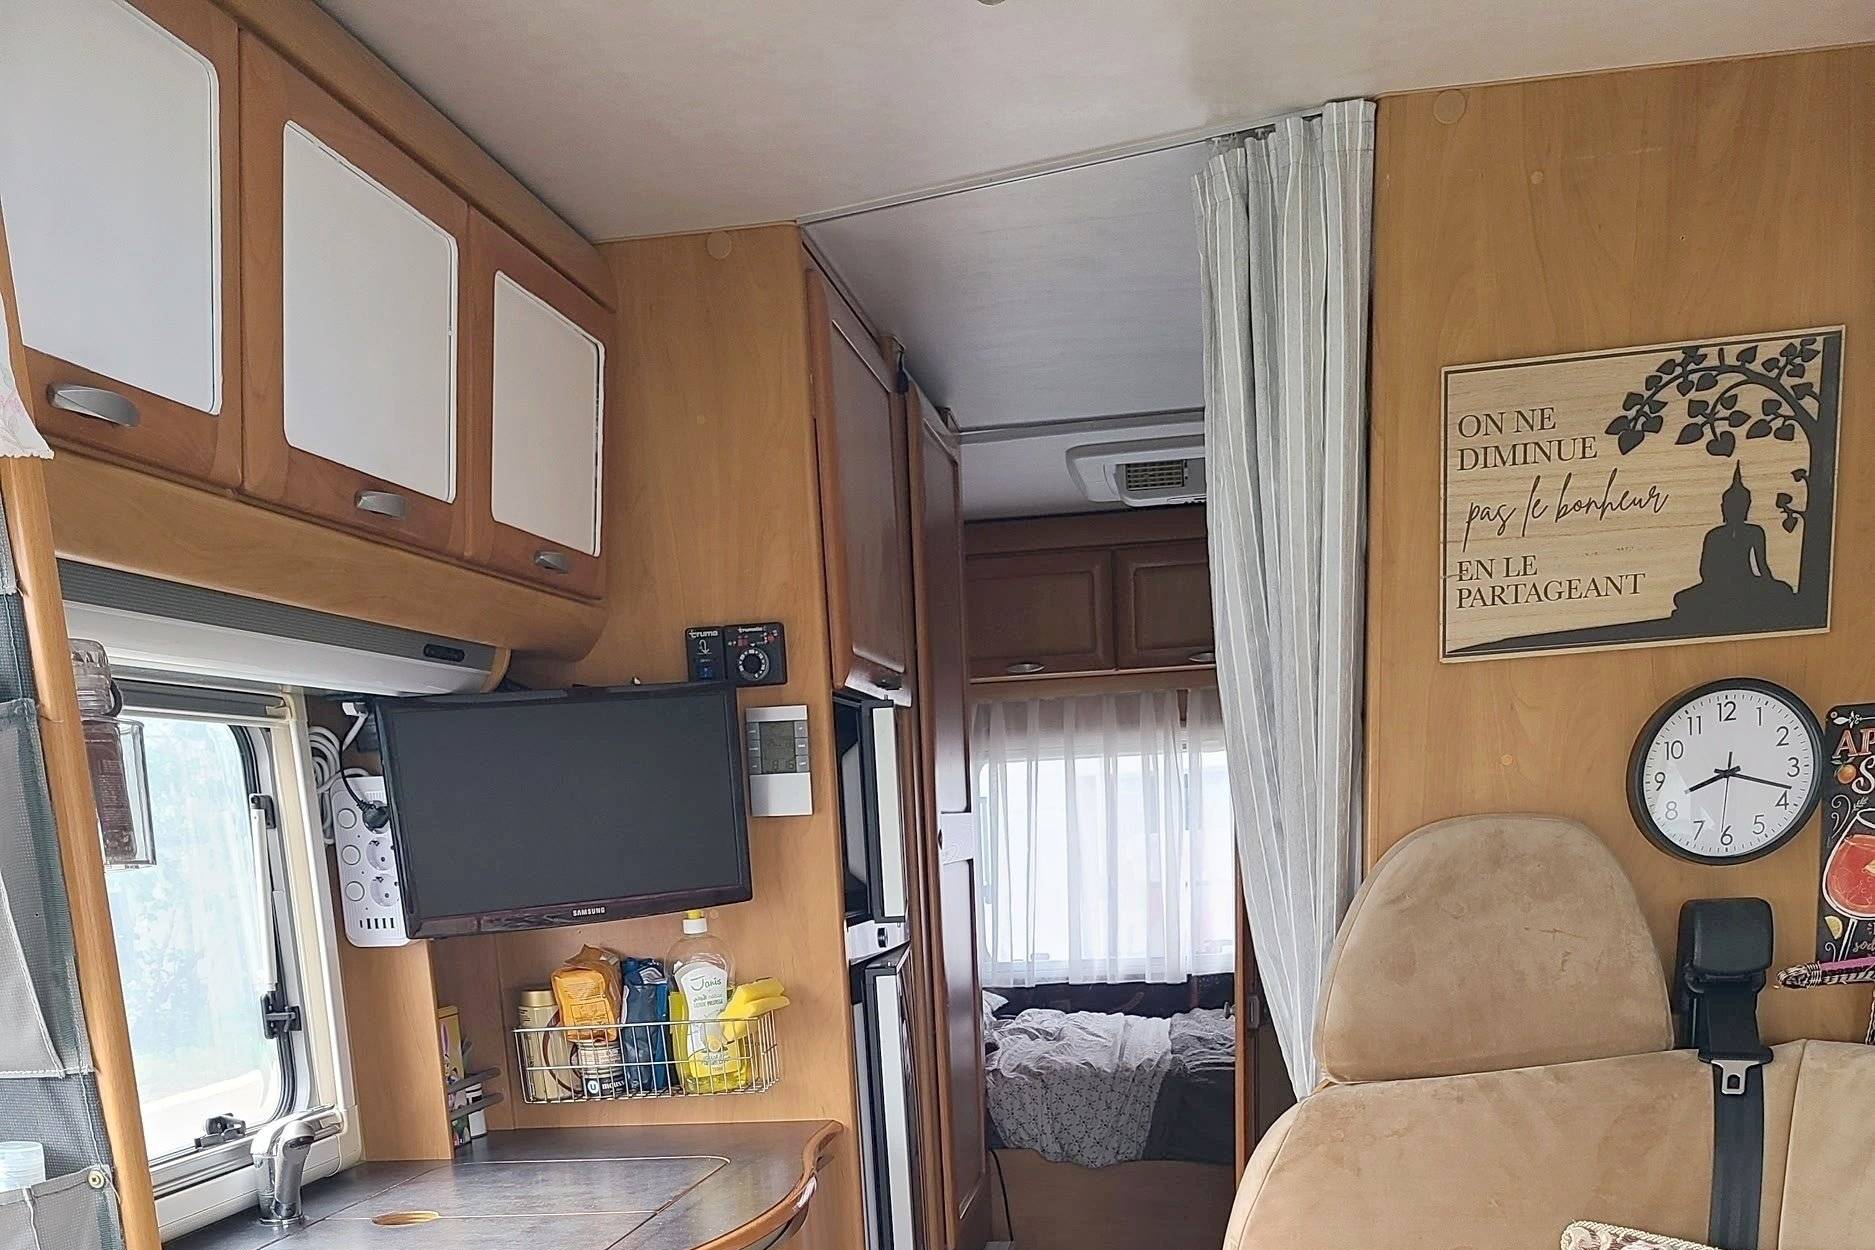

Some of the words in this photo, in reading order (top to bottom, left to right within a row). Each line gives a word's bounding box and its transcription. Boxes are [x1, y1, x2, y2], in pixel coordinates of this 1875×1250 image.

[1457, 410, 1505, 439] ON
[1514, 406, 1557, 435] NE
[1456, 436, 1598, 471] DIMINUE
[1462, 501, 1517, 553] pas
[1521, 475, 1548, 537] le
[1555, 468, 1669, 524] bonheur
[1456, 557, 1495, 582] EN
[1503, 554, 1538, 578] LE
[1456, 572, 1646, 609] PARTAGEANT
[1717, 701, 1737, 722] 12
[1756, 707, 1763, 727] 1
[1687, 715, 1703, 735] 11
[1776, 726, 1790, 747] 2
[1664, 739, 1685, 761] 10
[1787, 757, 1800, 777] 3
[1654, 771, 1666, 791] 9
[1775, 790, 1789, 810] 4
[1665, 801, 1678, 821] 8
[1693, 820, 1705, 841] 7
[1752, 814, 1765, 834] 5
[1720, 825, 1733, 846] 6
[572, 906, 606, 917] SAMSUNG
[690, 975, 722, 991] Janis
